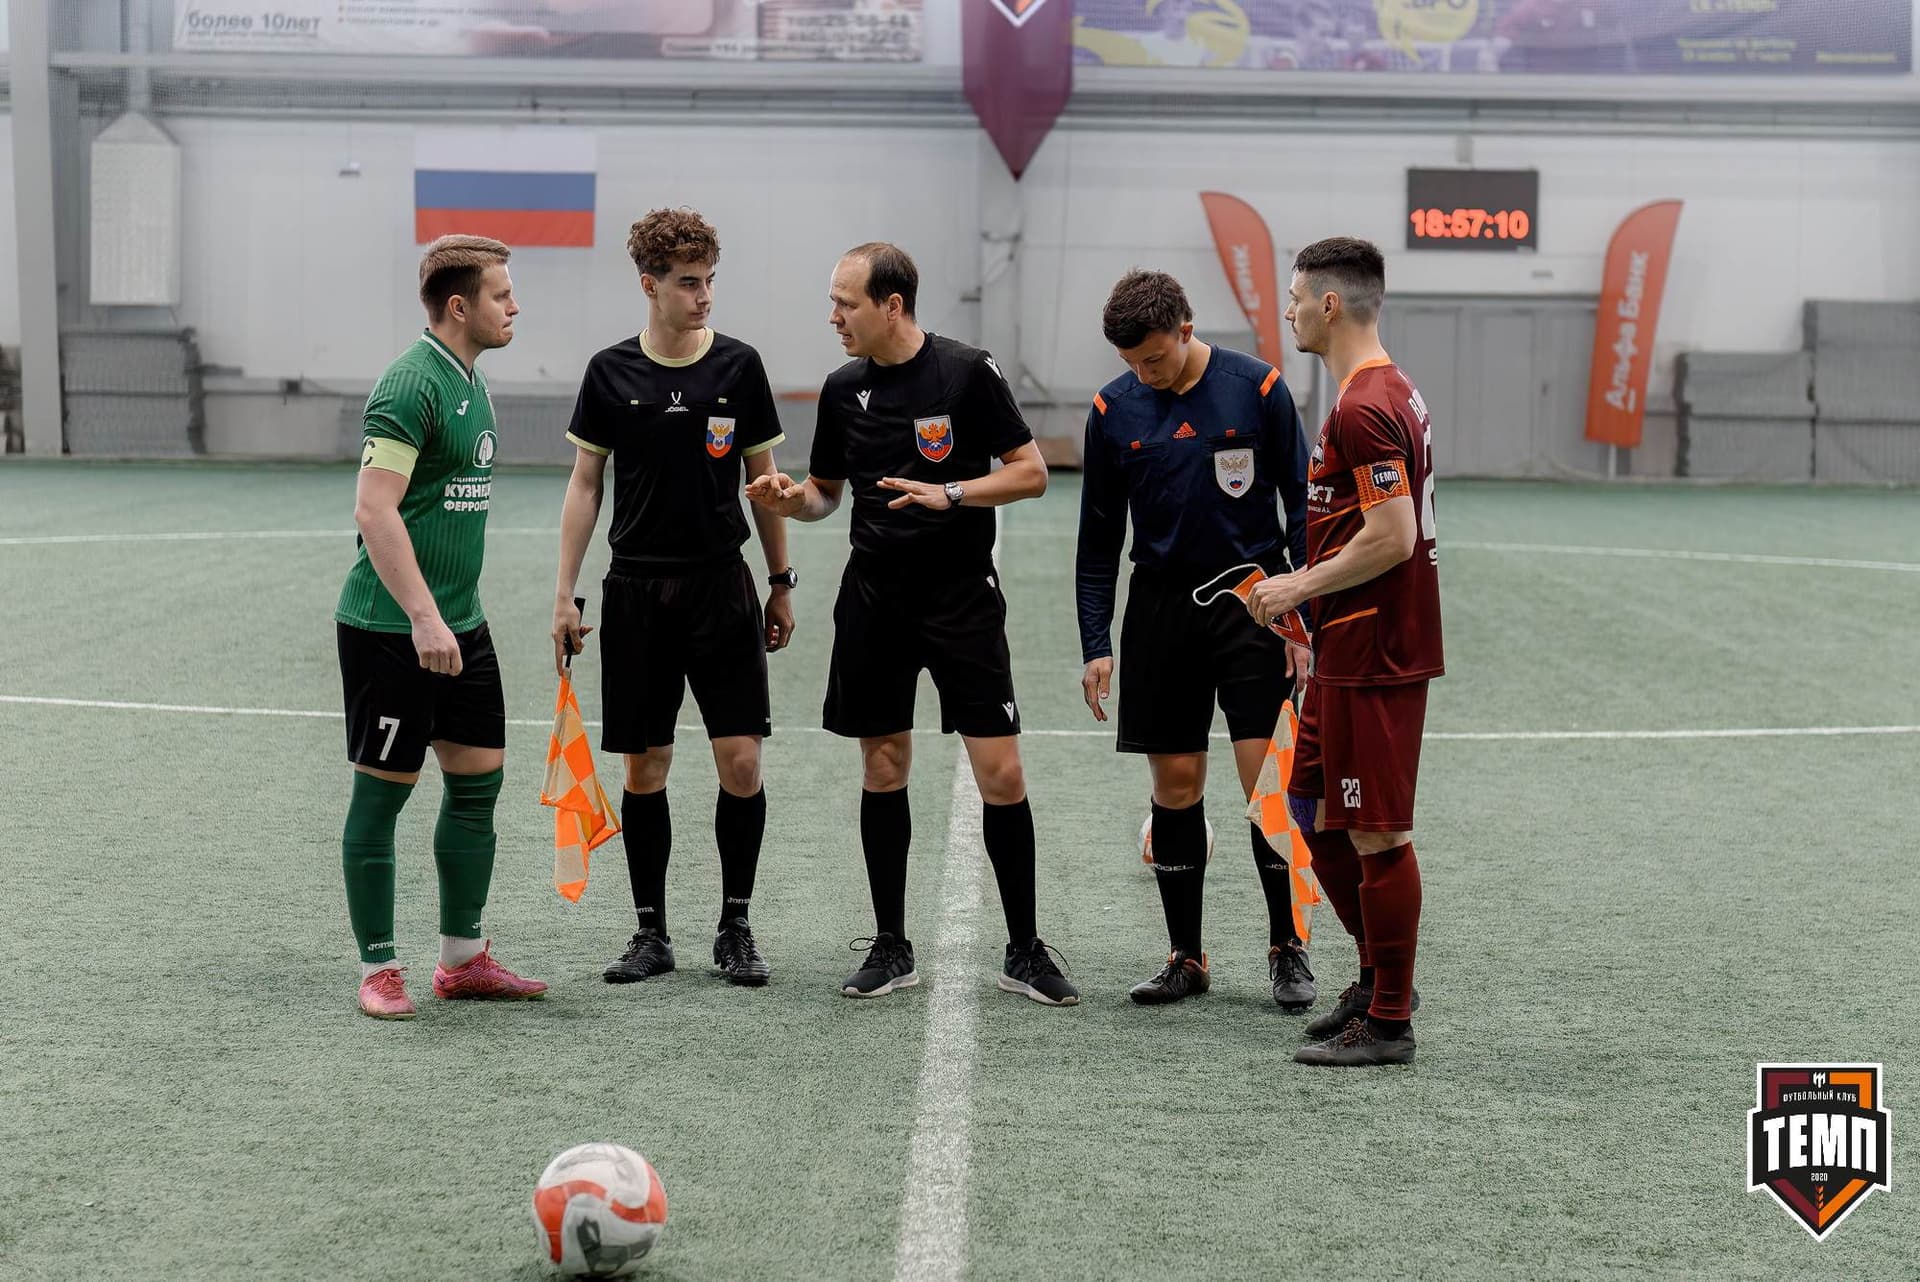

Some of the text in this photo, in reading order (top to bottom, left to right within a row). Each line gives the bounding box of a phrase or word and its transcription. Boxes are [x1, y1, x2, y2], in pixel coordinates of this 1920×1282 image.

[187, 10, 253, 29] более
[1410, 208, 1529, 239] 18:57:10
[1373, 470, 1399, 485] ТЕМП
[379, 716, 400, 761] 7
[1341, 778, 1361, 808] 23
